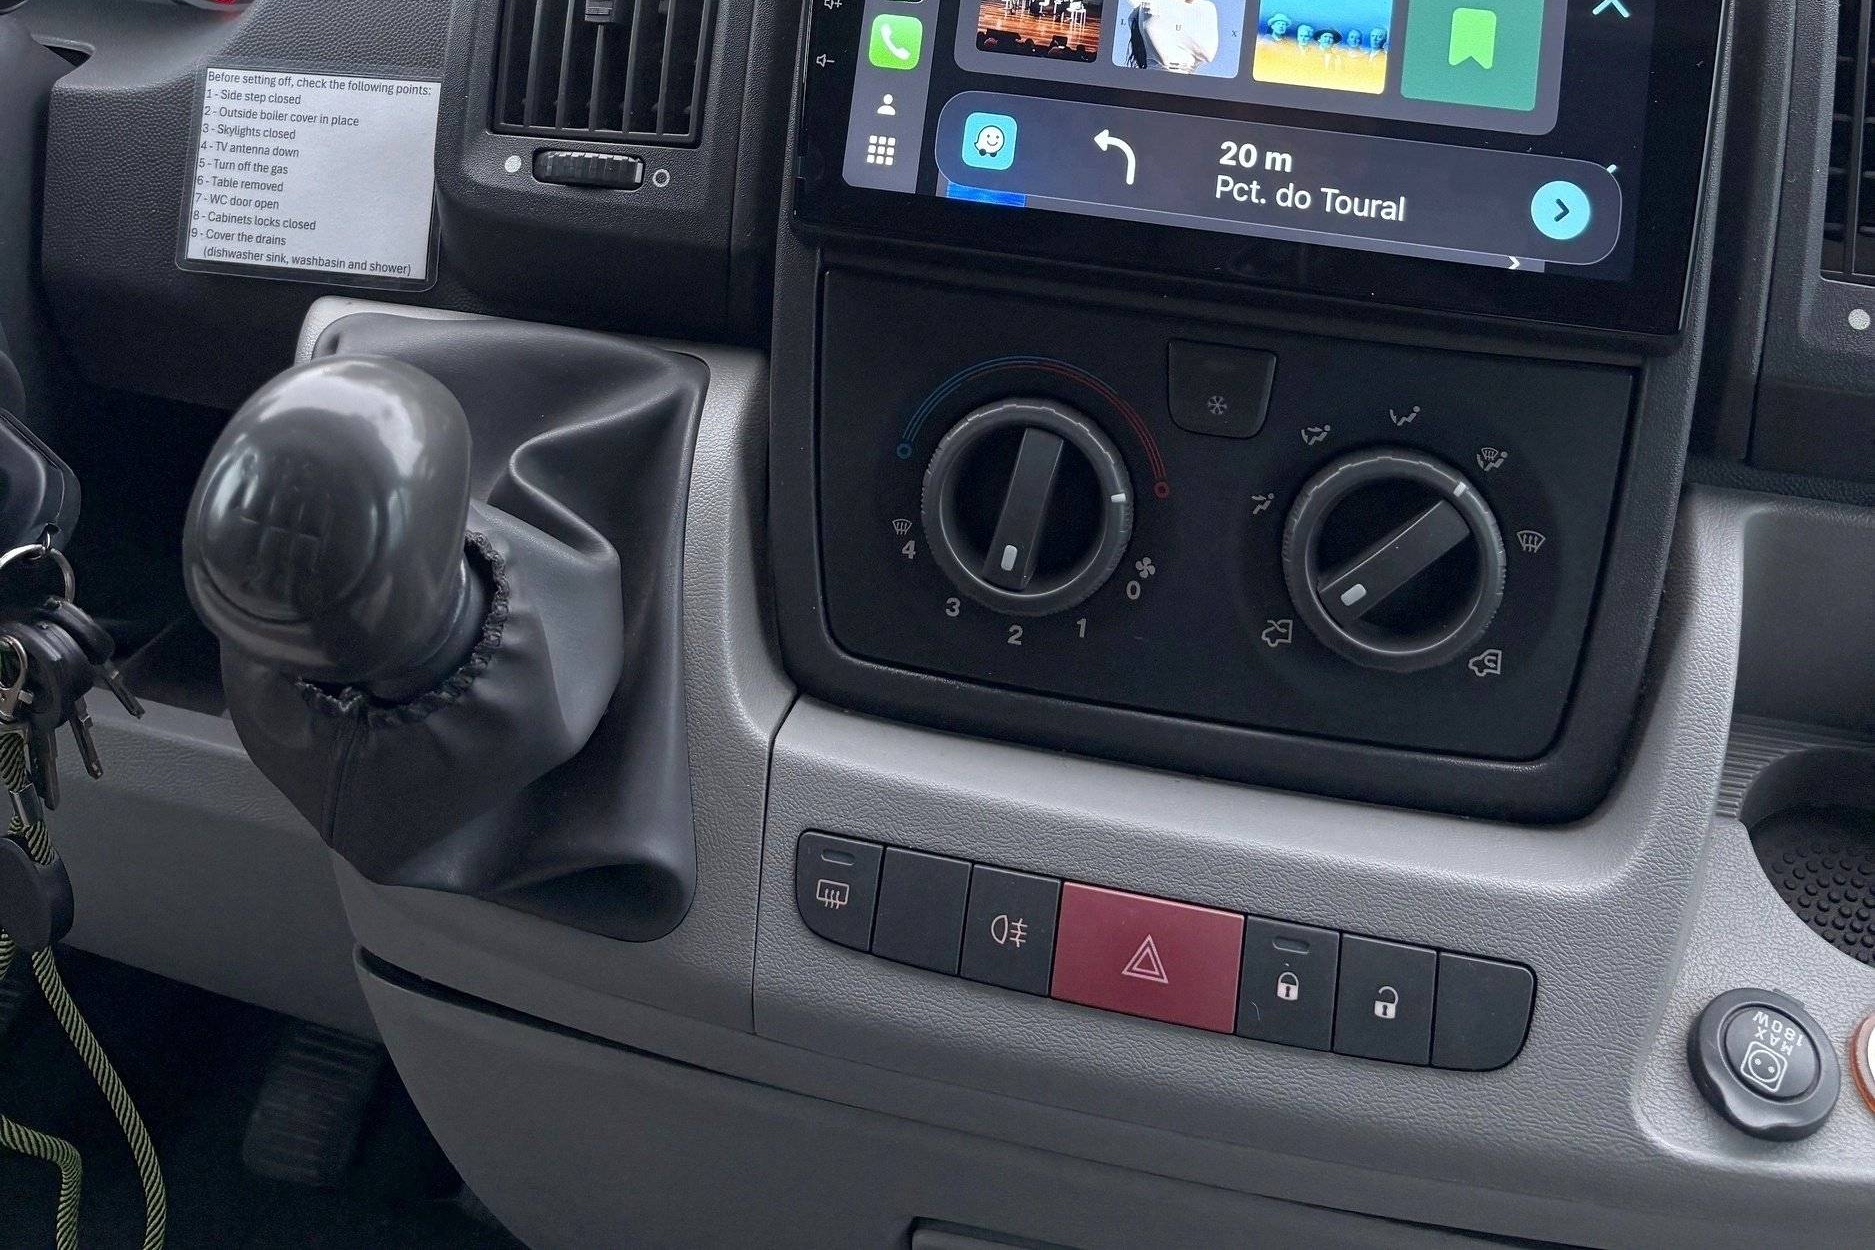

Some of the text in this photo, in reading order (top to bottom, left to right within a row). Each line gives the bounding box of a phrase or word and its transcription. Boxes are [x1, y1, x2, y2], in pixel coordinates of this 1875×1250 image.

[208, 71, 431, 96] Before setting off, check the following points:
[206, 89, 212, 99] 1
[220, 89, 242, 101] Side
[244, 92, 267, 104] step
[268, 93, 302, 105] closed
[204, 105, 211, 116] 2
[219, 106, 258, 119] Outside
[260, 110, 288, 121] boiler
[290, 114, 317, 123] cover
[319, 114, 329, 124] in
[331, 115, 359, 127] place
[202, 123, 209, 133] 3
[217, 123, 261, 138] Skylights
[263, 128, 296, 140] closed
[200, 141, 208, 150] 4
[216, 141, 228, 152] TV
[229, 144, 270, 156] antenna
[272, 146, 300, 157] down
[1219, 140, 1292, 173] 20 m
[199, 157, 205, 168] 5
[214, 158, 236, 170] Turn
[237, 161, 252, 171] off
[253, 162, 269, 173] the
[270, 165, 288, 176] gas
[197, 175, 204, 185] 6
[212, 175, 239, 189] Table
[240, 181, 284, 192] removed
[196, 192, 202, 202] 7
[210, 193, 228, 205] WC
[229, 196, 253, 207] door
[254, 199, 279, 210] open
[1215, 175, 1405, 222] Pct. do Toural
[193, 210, 200, 220] 8
[208, 211, 253, 225] Cabinets
[254, 215, 280, 228] locks
[282, 218, 316, 231] closed
[191, 227, 198, 238] 9
[205, 228, 235, 241] Cover
[237, 231, 254, 243] the
[255, 234, 286, 246] drains
[203, 246, 411, 277] (dishwasher sink, washbasin and shower)
[901, 540, 917, 559] 4
[1126, 580, 1142, 600] 0
[945, 597, 961, 617] 3
[1007, 624, 1024, 646] 2
[1076, 617, 1088, 638] 1
[1752, 1011, 1803, 1047] 180W
[1755, 1026, 1794, 1056] MAX
